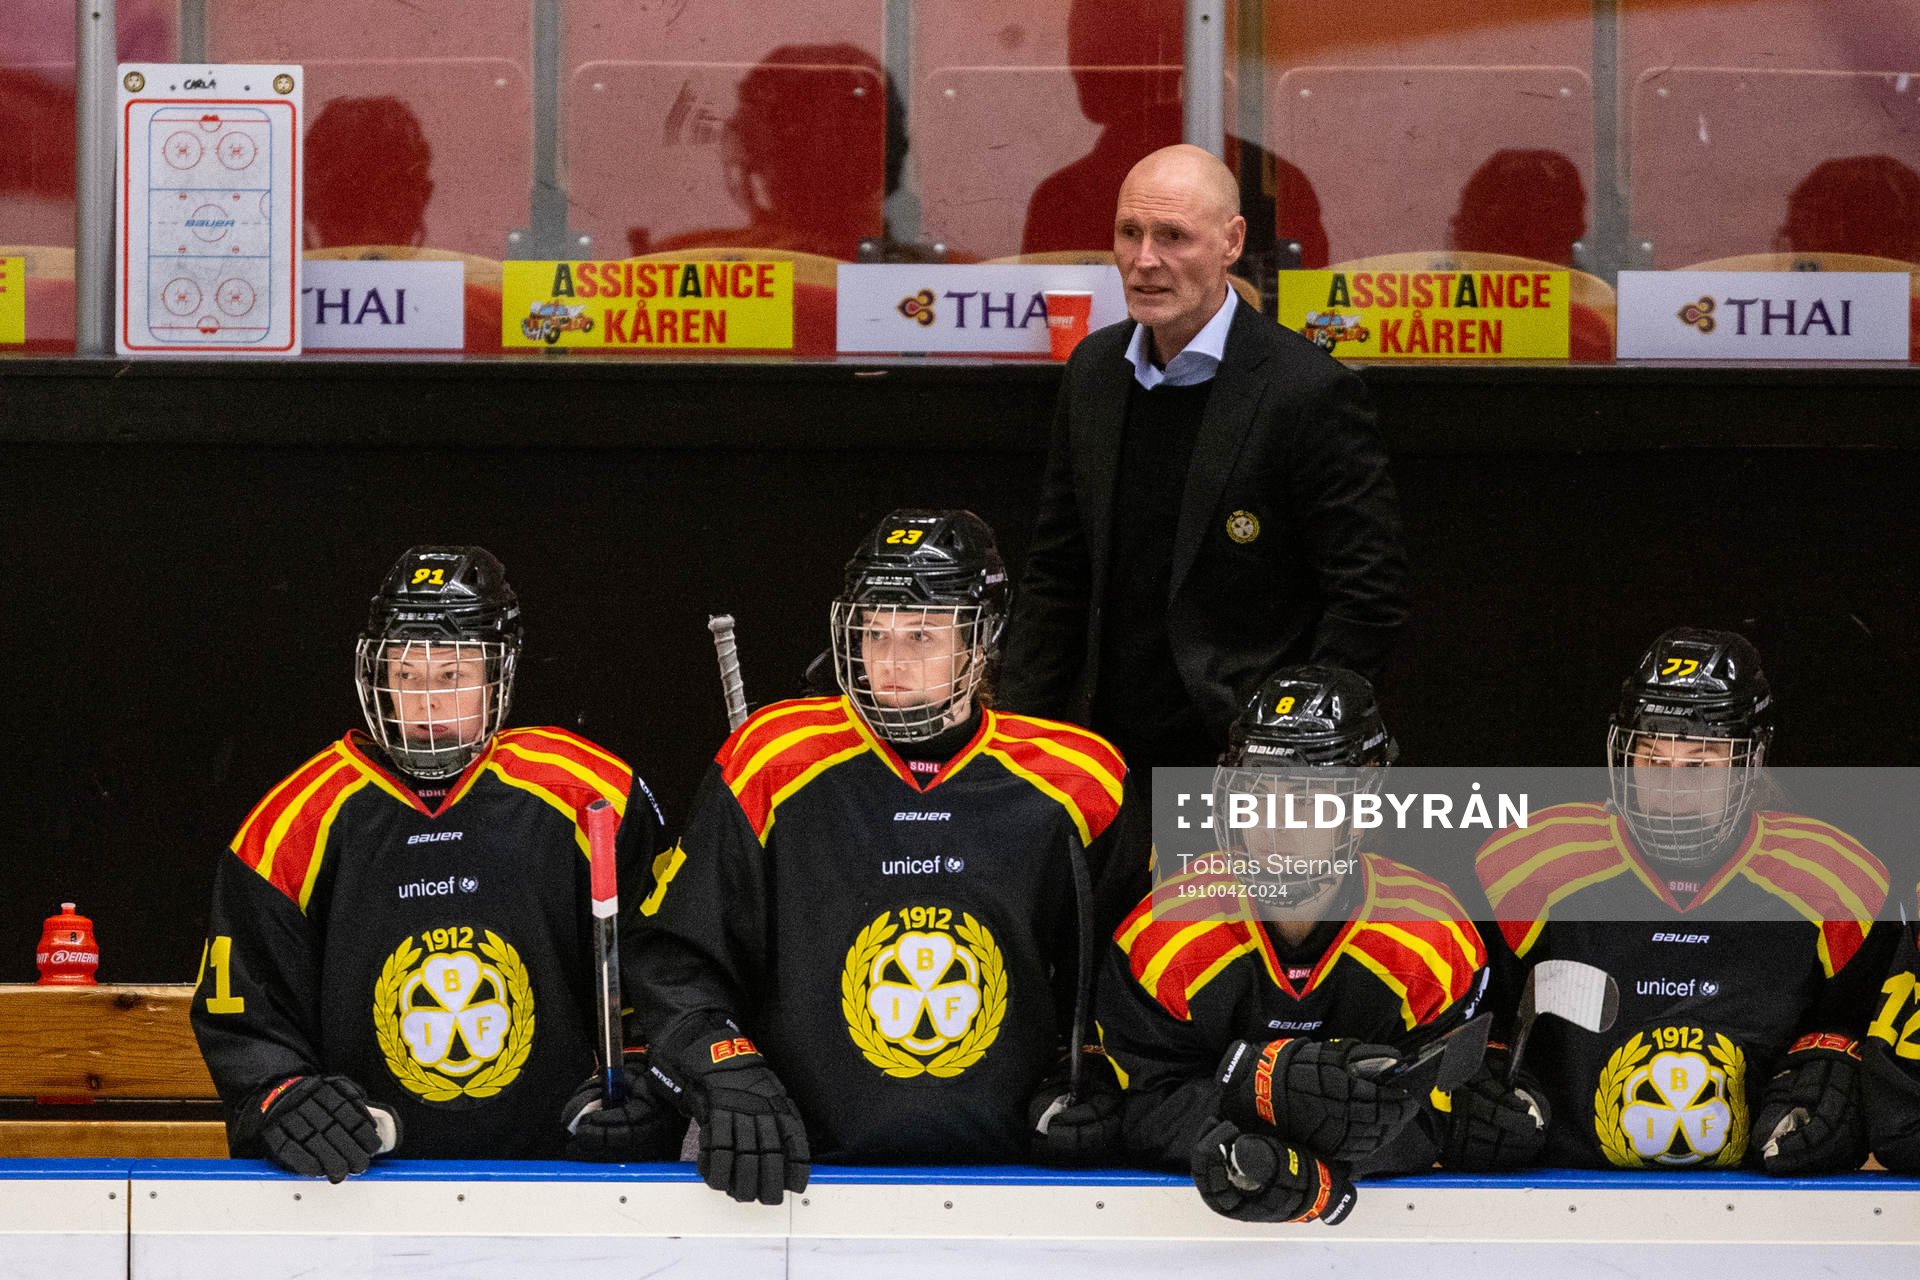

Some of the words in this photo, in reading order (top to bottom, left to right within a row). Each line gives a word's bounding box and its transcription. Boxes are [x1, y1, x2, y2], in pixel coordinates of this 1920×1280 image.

[551, 263, 775, 299] ASSISTANCE
[1326, 272, 1552, 308] ASSISTANCE
[301, 287, 406, 325] HAI
[943, 290, 1050, 328] THA
[1723, 297, 1852, 336] THAI
[603, 299, 728, 344] KÅREN
[1379, 310, 1503, 354] KÅREN
[886, 529, 924, 545] 23
[411, 568, 445, 586] 91
[1661, 658, 1700, 677] 77
[1275, 696, 1296, 715] 8
[909, 761, 941, 773] SDHL
[893, 812, 951, 821] BAUER
[407, 831, 464, 845] BAUER
[881, 855, 941, 875] unicef
[398, 876, 455, 899] unicef
[1669, 881, 1699, 893] SDHL
[899, 906, 953, 931] 1912
[421, 926, 475, 952] 1912
[1651, 932, 1710, 944] BAUER
[917, 947, 935, 971] B
[443, 968, 462, 992] B
[1636, 977, 1696, 997] unicef
[1651, 1026, 1705, 1050] 1912
[1670, 1067, 1689, 1092] B
